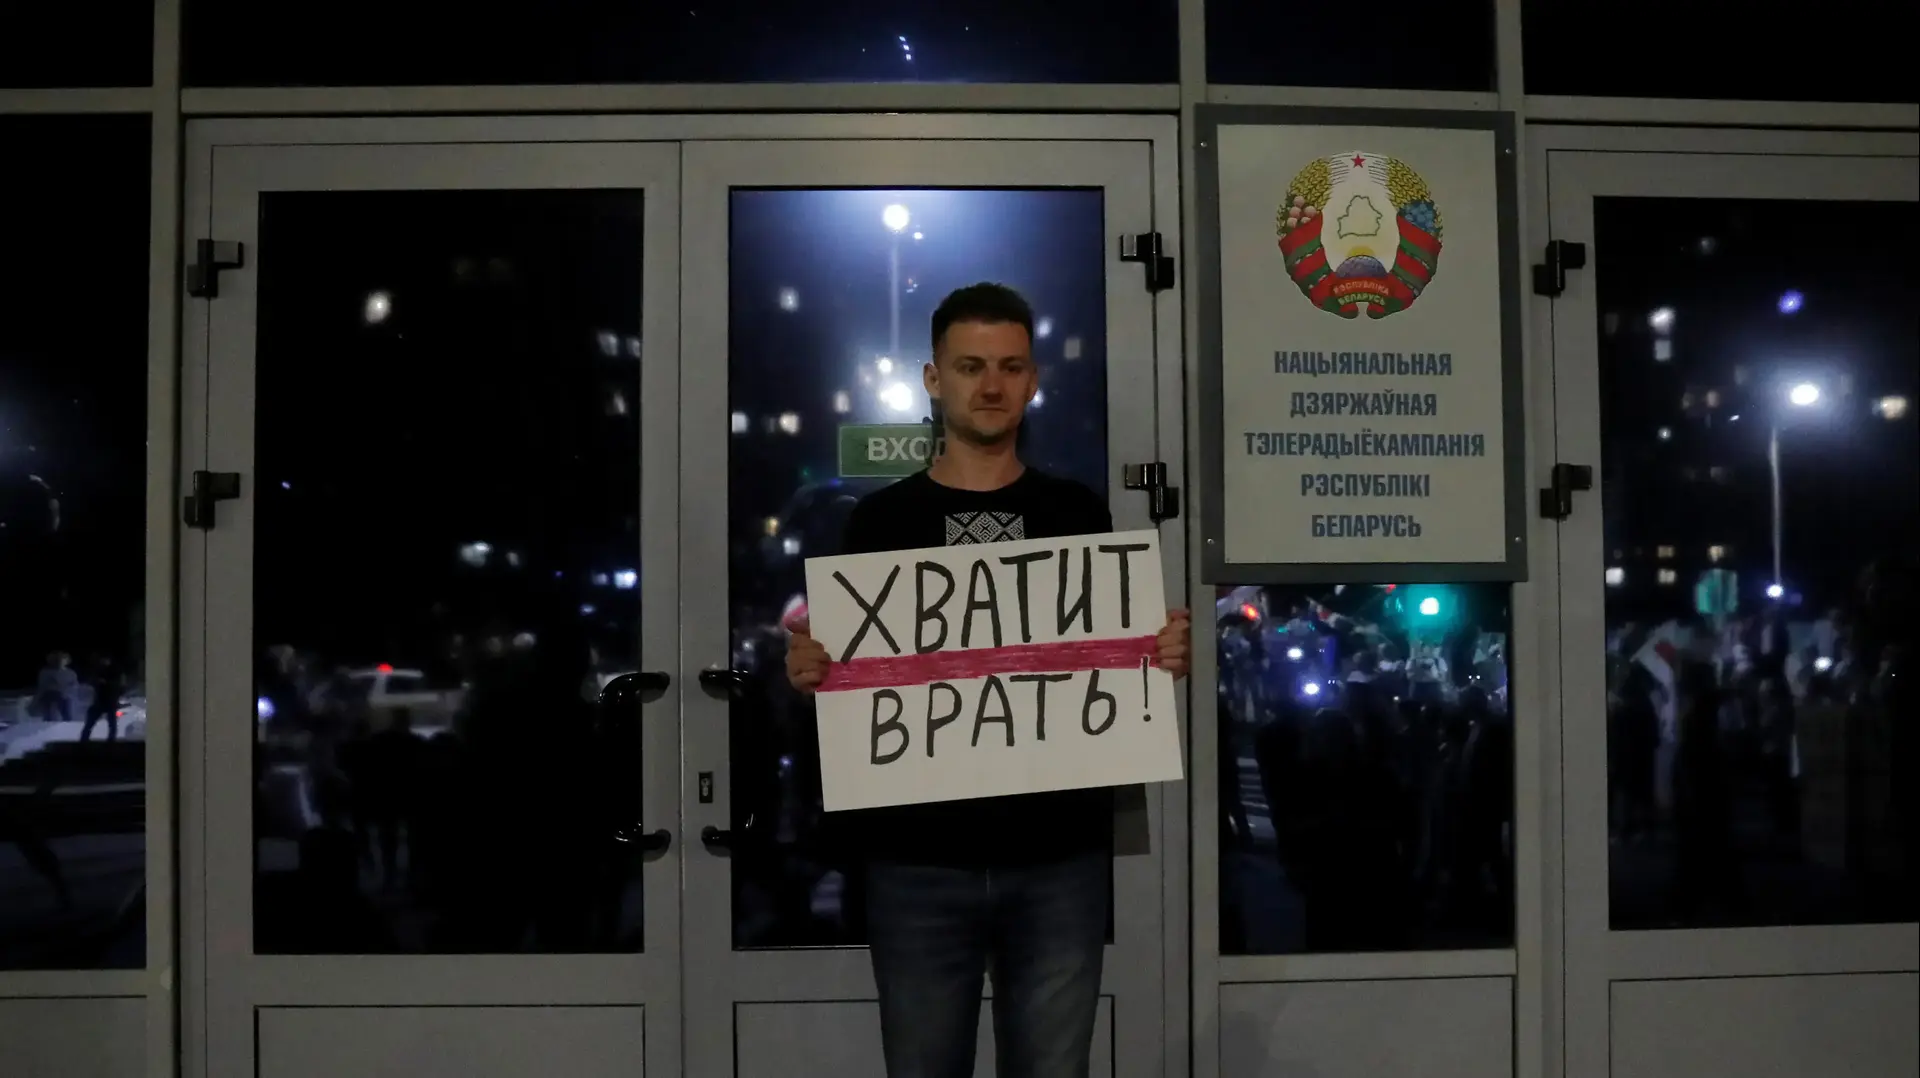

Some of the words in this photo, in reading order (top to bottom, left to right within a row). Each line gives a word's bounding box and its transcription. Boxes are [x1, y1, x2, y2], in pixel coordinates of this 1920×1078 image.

[1274, 351, 1452, 377] НАЦЫЯНАЛЬНАЯ
[1290, 390, 1437, 418] ДЗЯРЖАЎНАЯ
[1244, 428, 1485, 459] ТЭЛЕРАДЫЁКАМПАНІЯ
[1300, 473, 1430, 498] РЭСПУБЛІКІ
[1311, 514, 1422, 538] БЕЛАРУСЬ
[832, 543, 1151, 665] ХВАТИТ
[870, 656, 1152, 764] ВРАТЬ!
